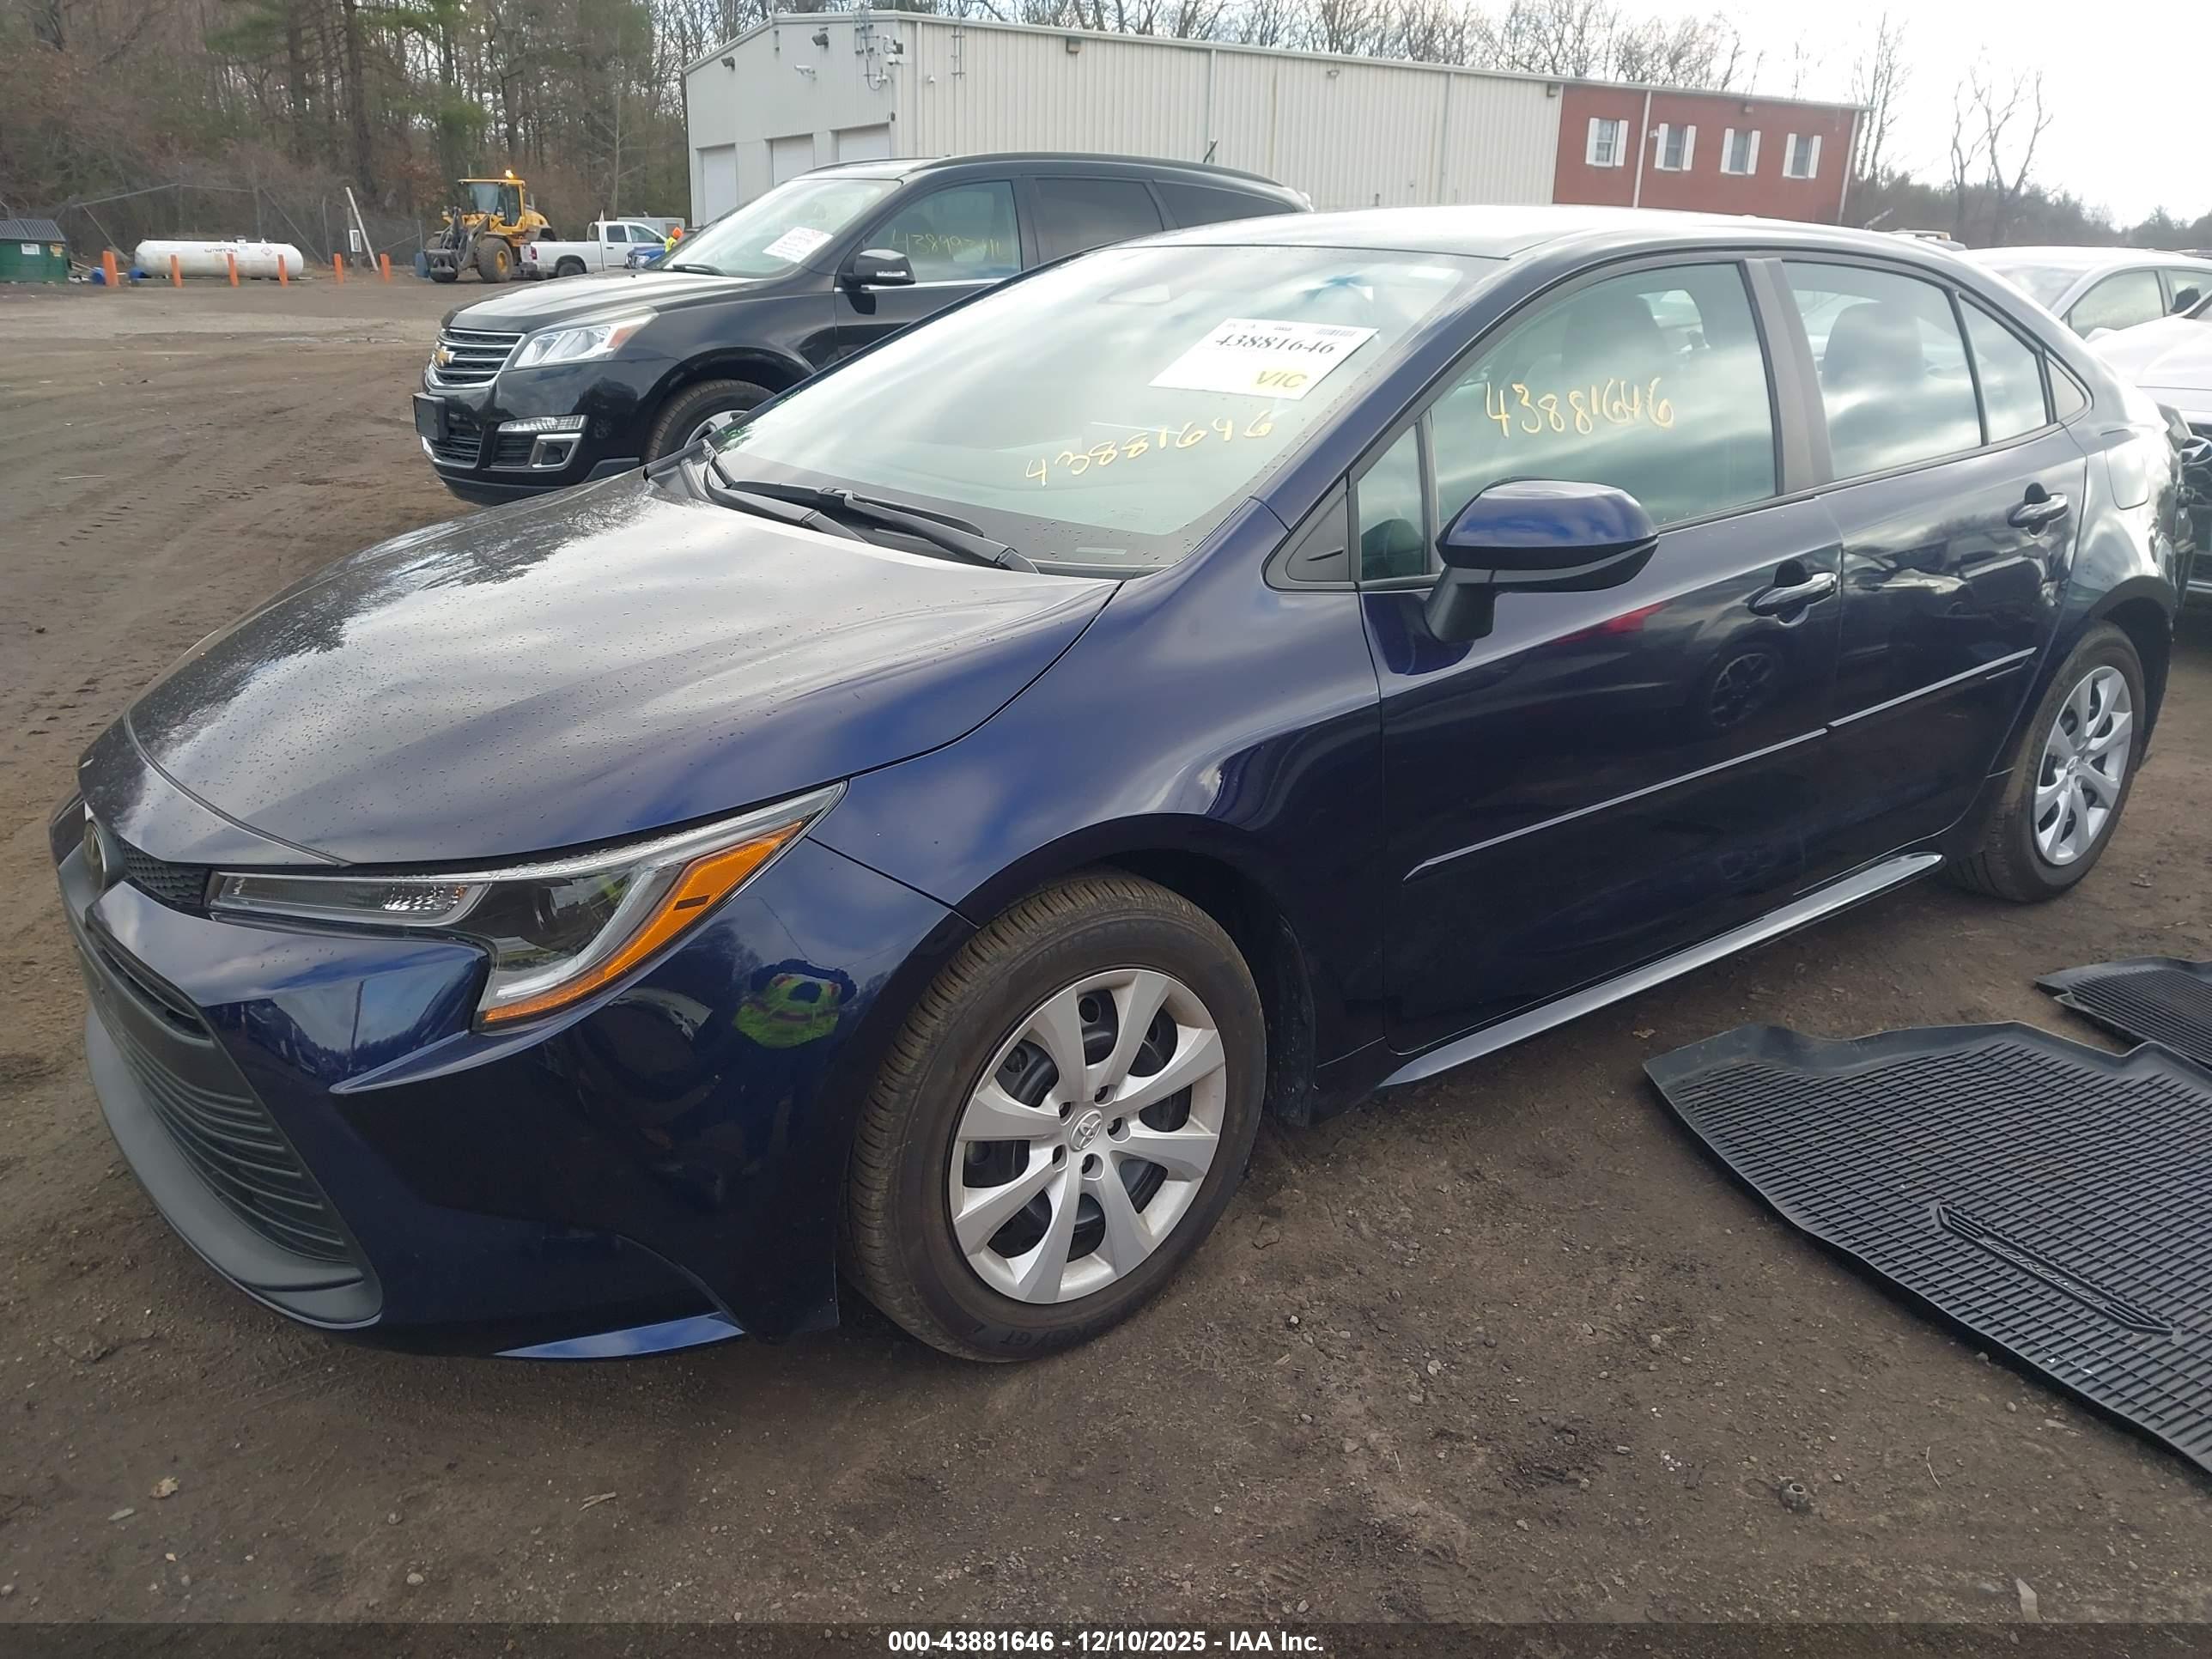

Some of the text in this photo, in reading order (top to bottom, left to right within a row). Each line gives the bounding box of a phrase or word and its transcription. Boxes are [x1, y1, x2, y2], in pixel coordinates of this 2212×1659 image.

[1215, 333, 1336, 355] 43881646
[1255, 370, 1309, 389] VIC
[1486, 377, 1674, 437] 43881646
[1025, 409, 1273, 487] 43881646
